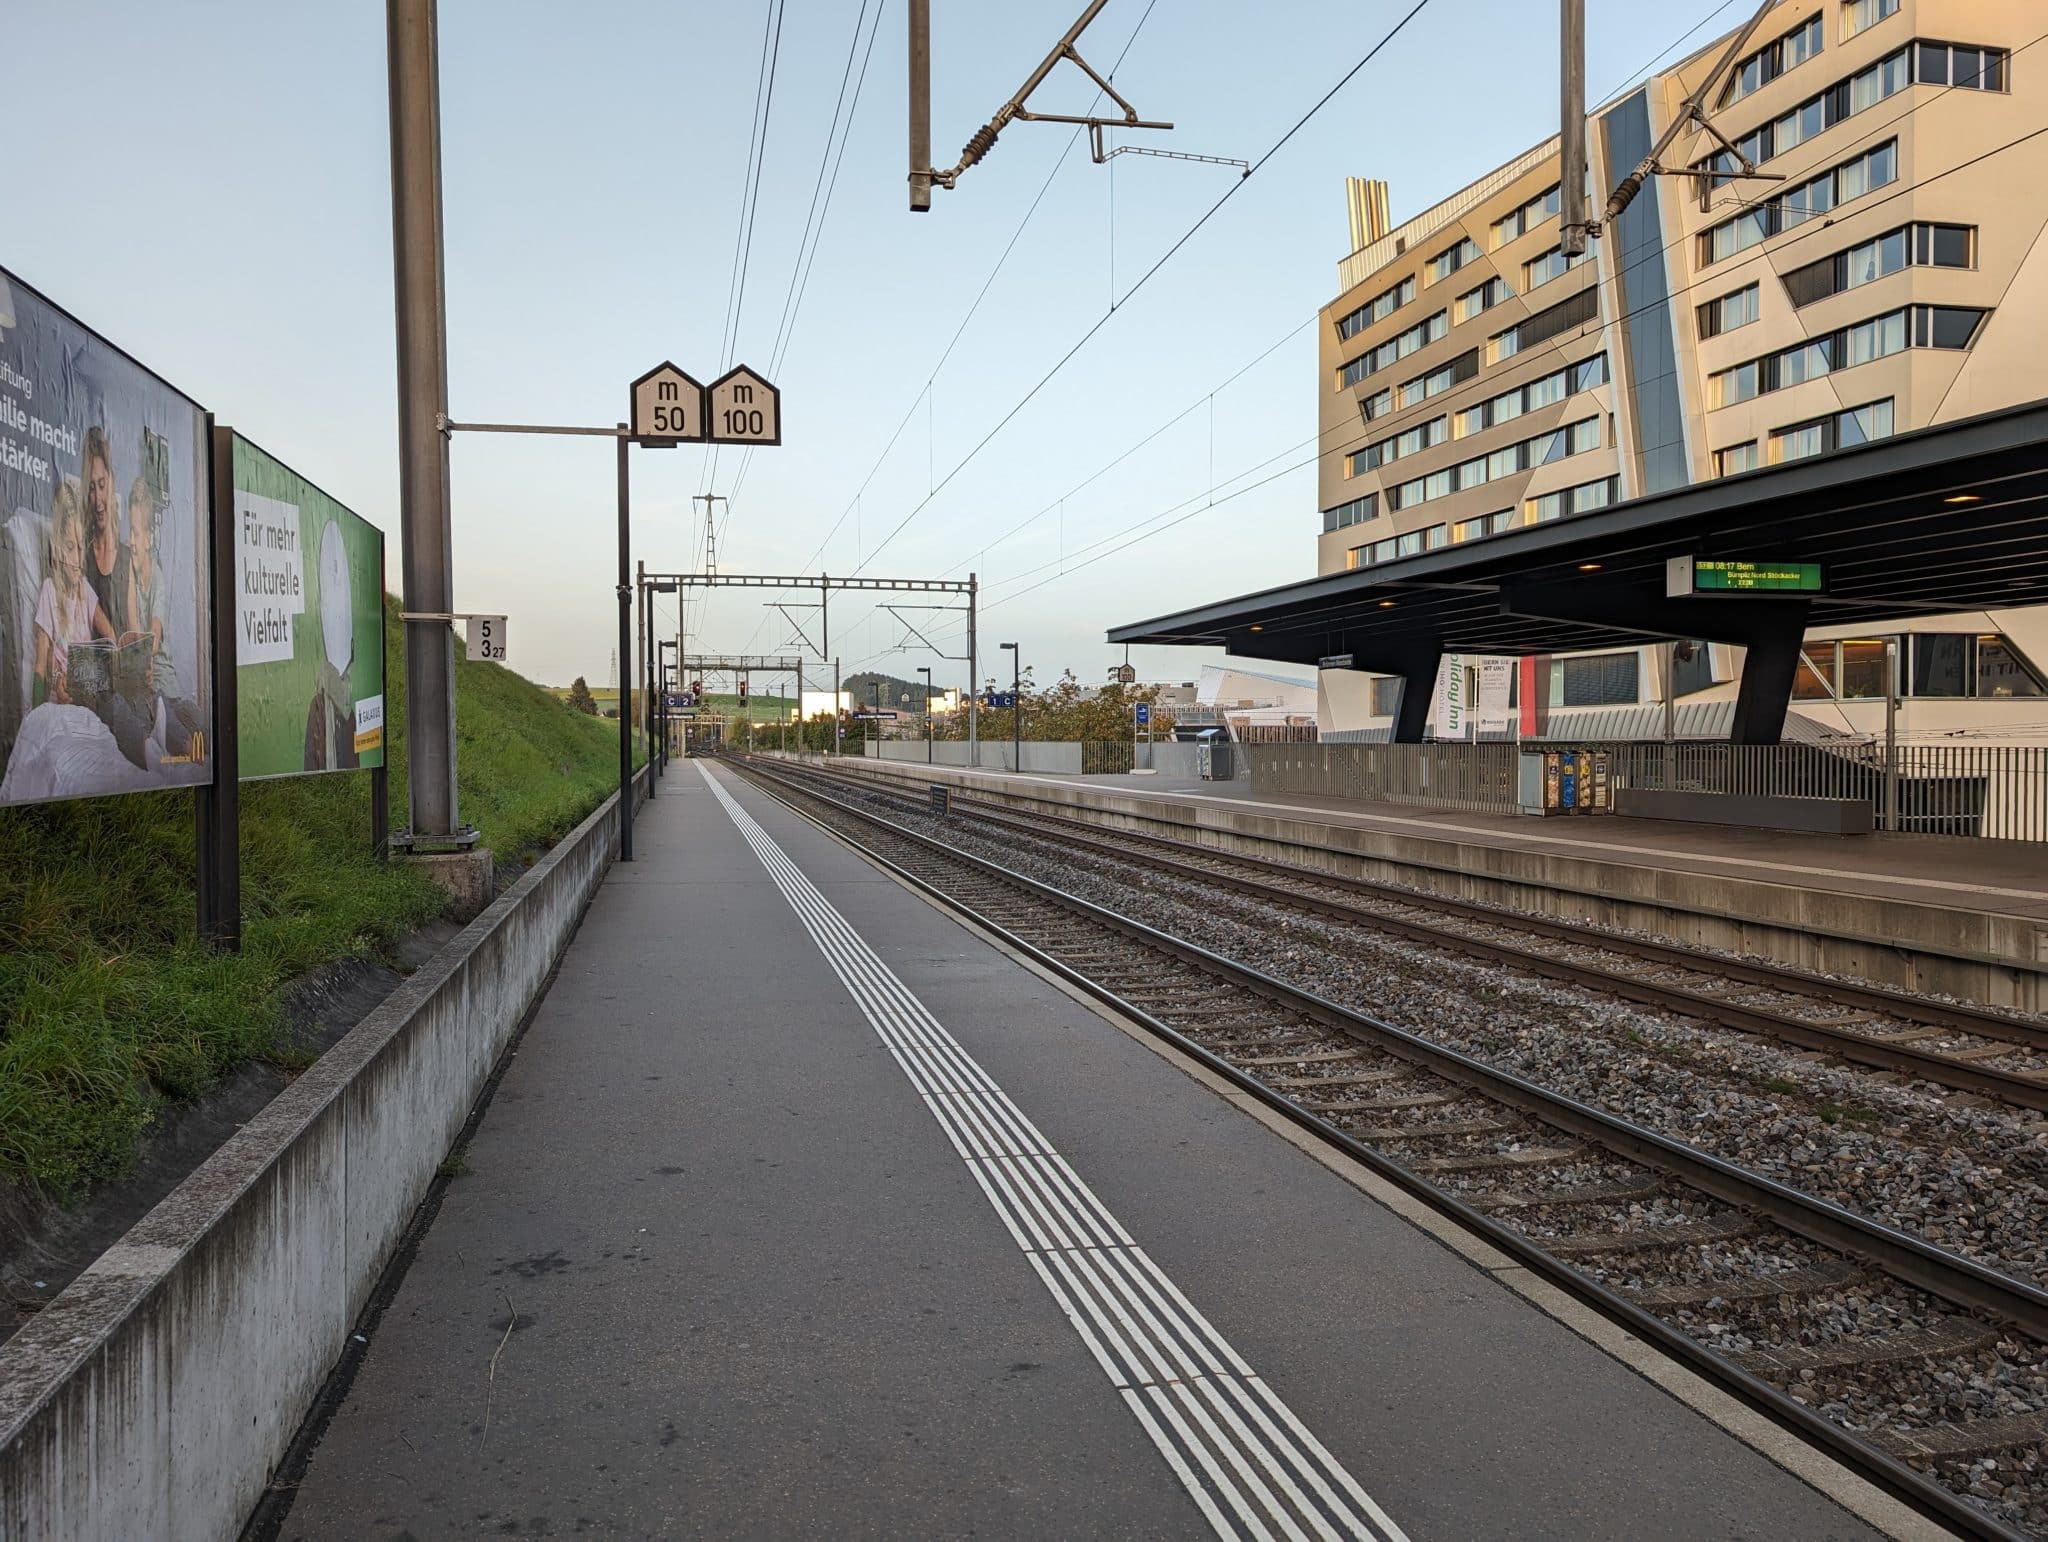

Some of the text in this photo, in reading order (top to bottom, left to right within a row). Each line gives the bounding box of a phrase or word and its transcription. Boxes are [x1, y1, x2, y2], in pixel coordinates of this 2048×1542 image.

[658, 381, 678, 401] m
[733, 384, 753, 404] m
[654, 406, 685, 432] 50
[723, 409, 764, 435] 100
[30, 415, 77, 457] macht
[243, 510, 296, 553] Für mehr
[243, 557, 300, 597] kulturelle
[1736, 562, 1755, 571] Bern
[243, 607, 288, 646] Vielfalt
[481, 620, 491, 638] 5
[1449, 704, 1464, 730] Inn
